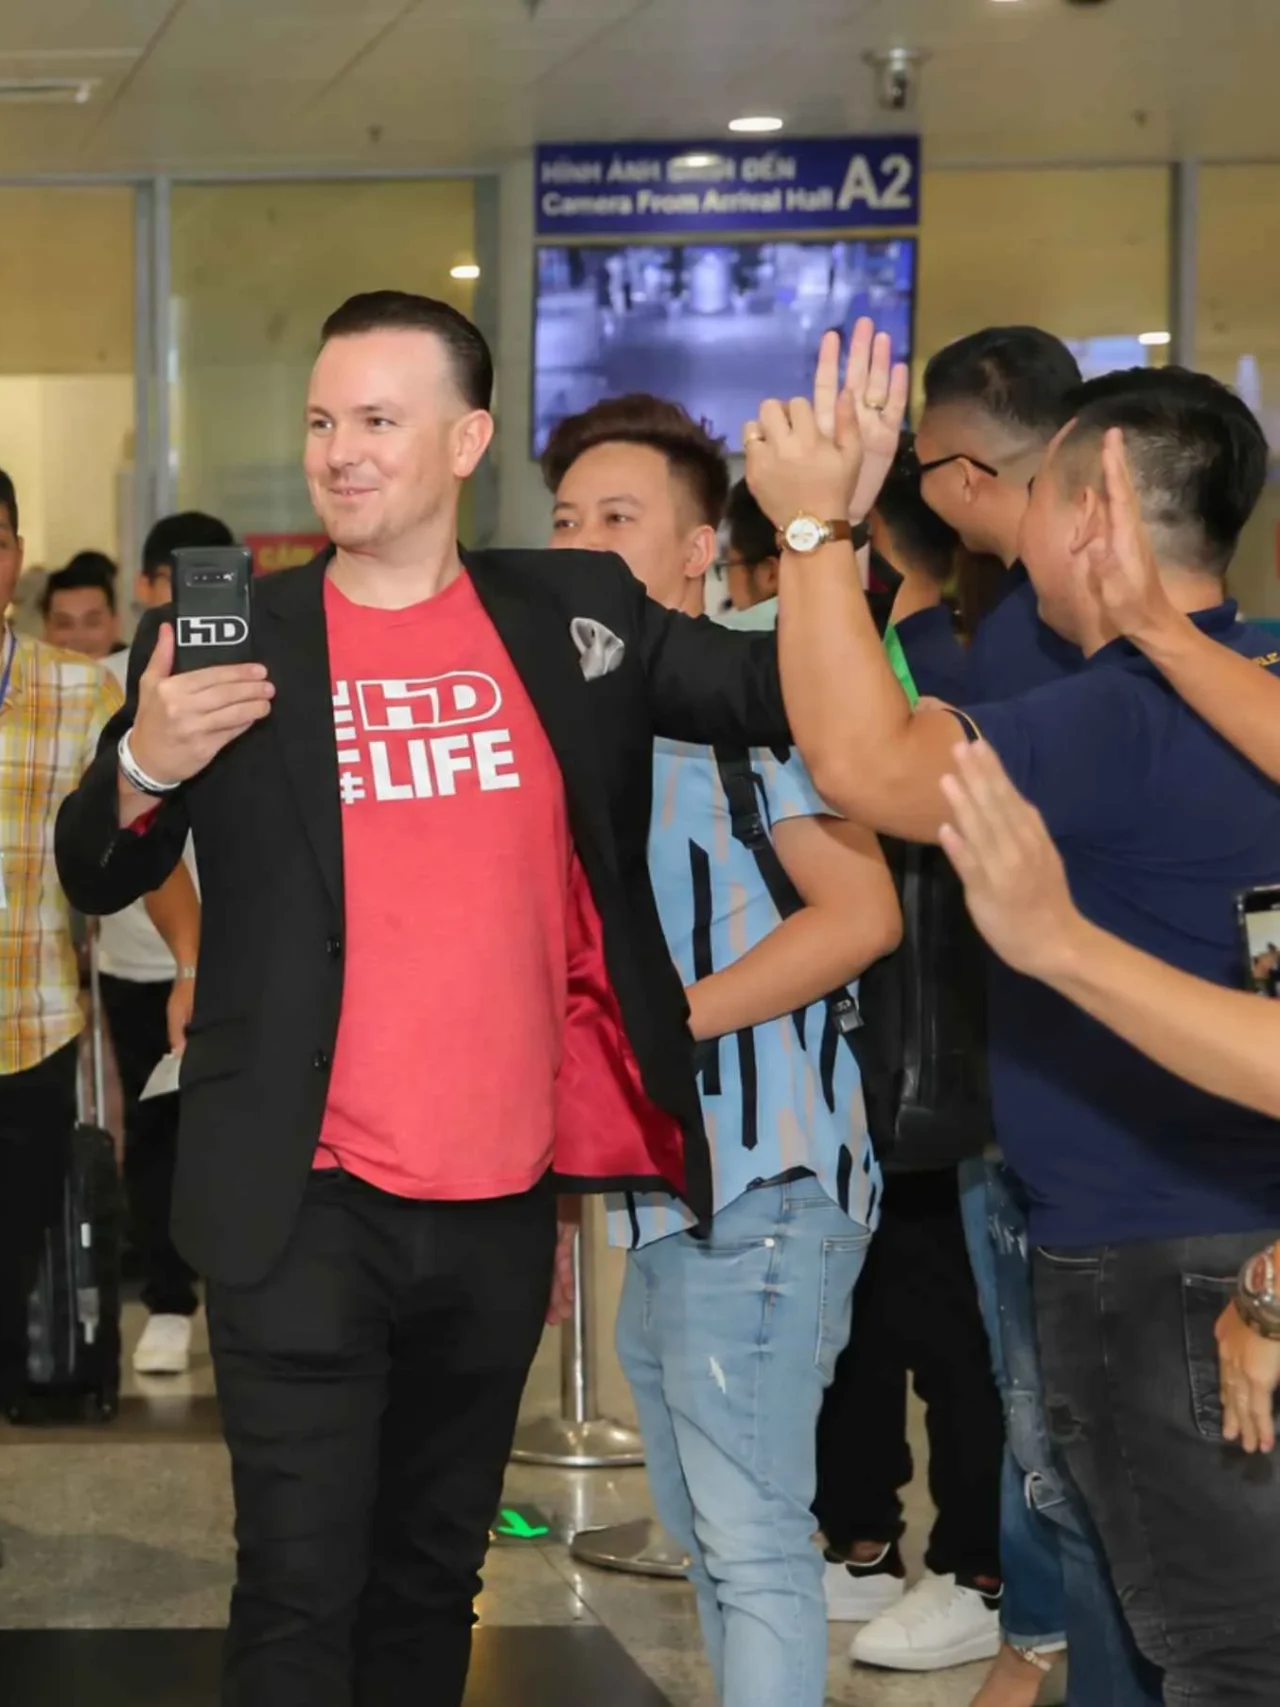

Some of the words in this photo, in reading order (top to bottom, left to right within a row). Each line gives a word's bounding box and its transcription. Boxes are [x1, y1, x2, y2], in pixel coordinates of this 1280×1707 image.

[542, 190, 633, 217] Camera
[636, 188, 700, 215] From
[701, 187, 782, 214] Arrival
[785, 185, 834, 212] Hall
[837, 153, 912, 210] A2
[177, 616, 248, 647] HD
[355, 670, 502, 731] HD
[369, 728, 520, 801] LIFE
